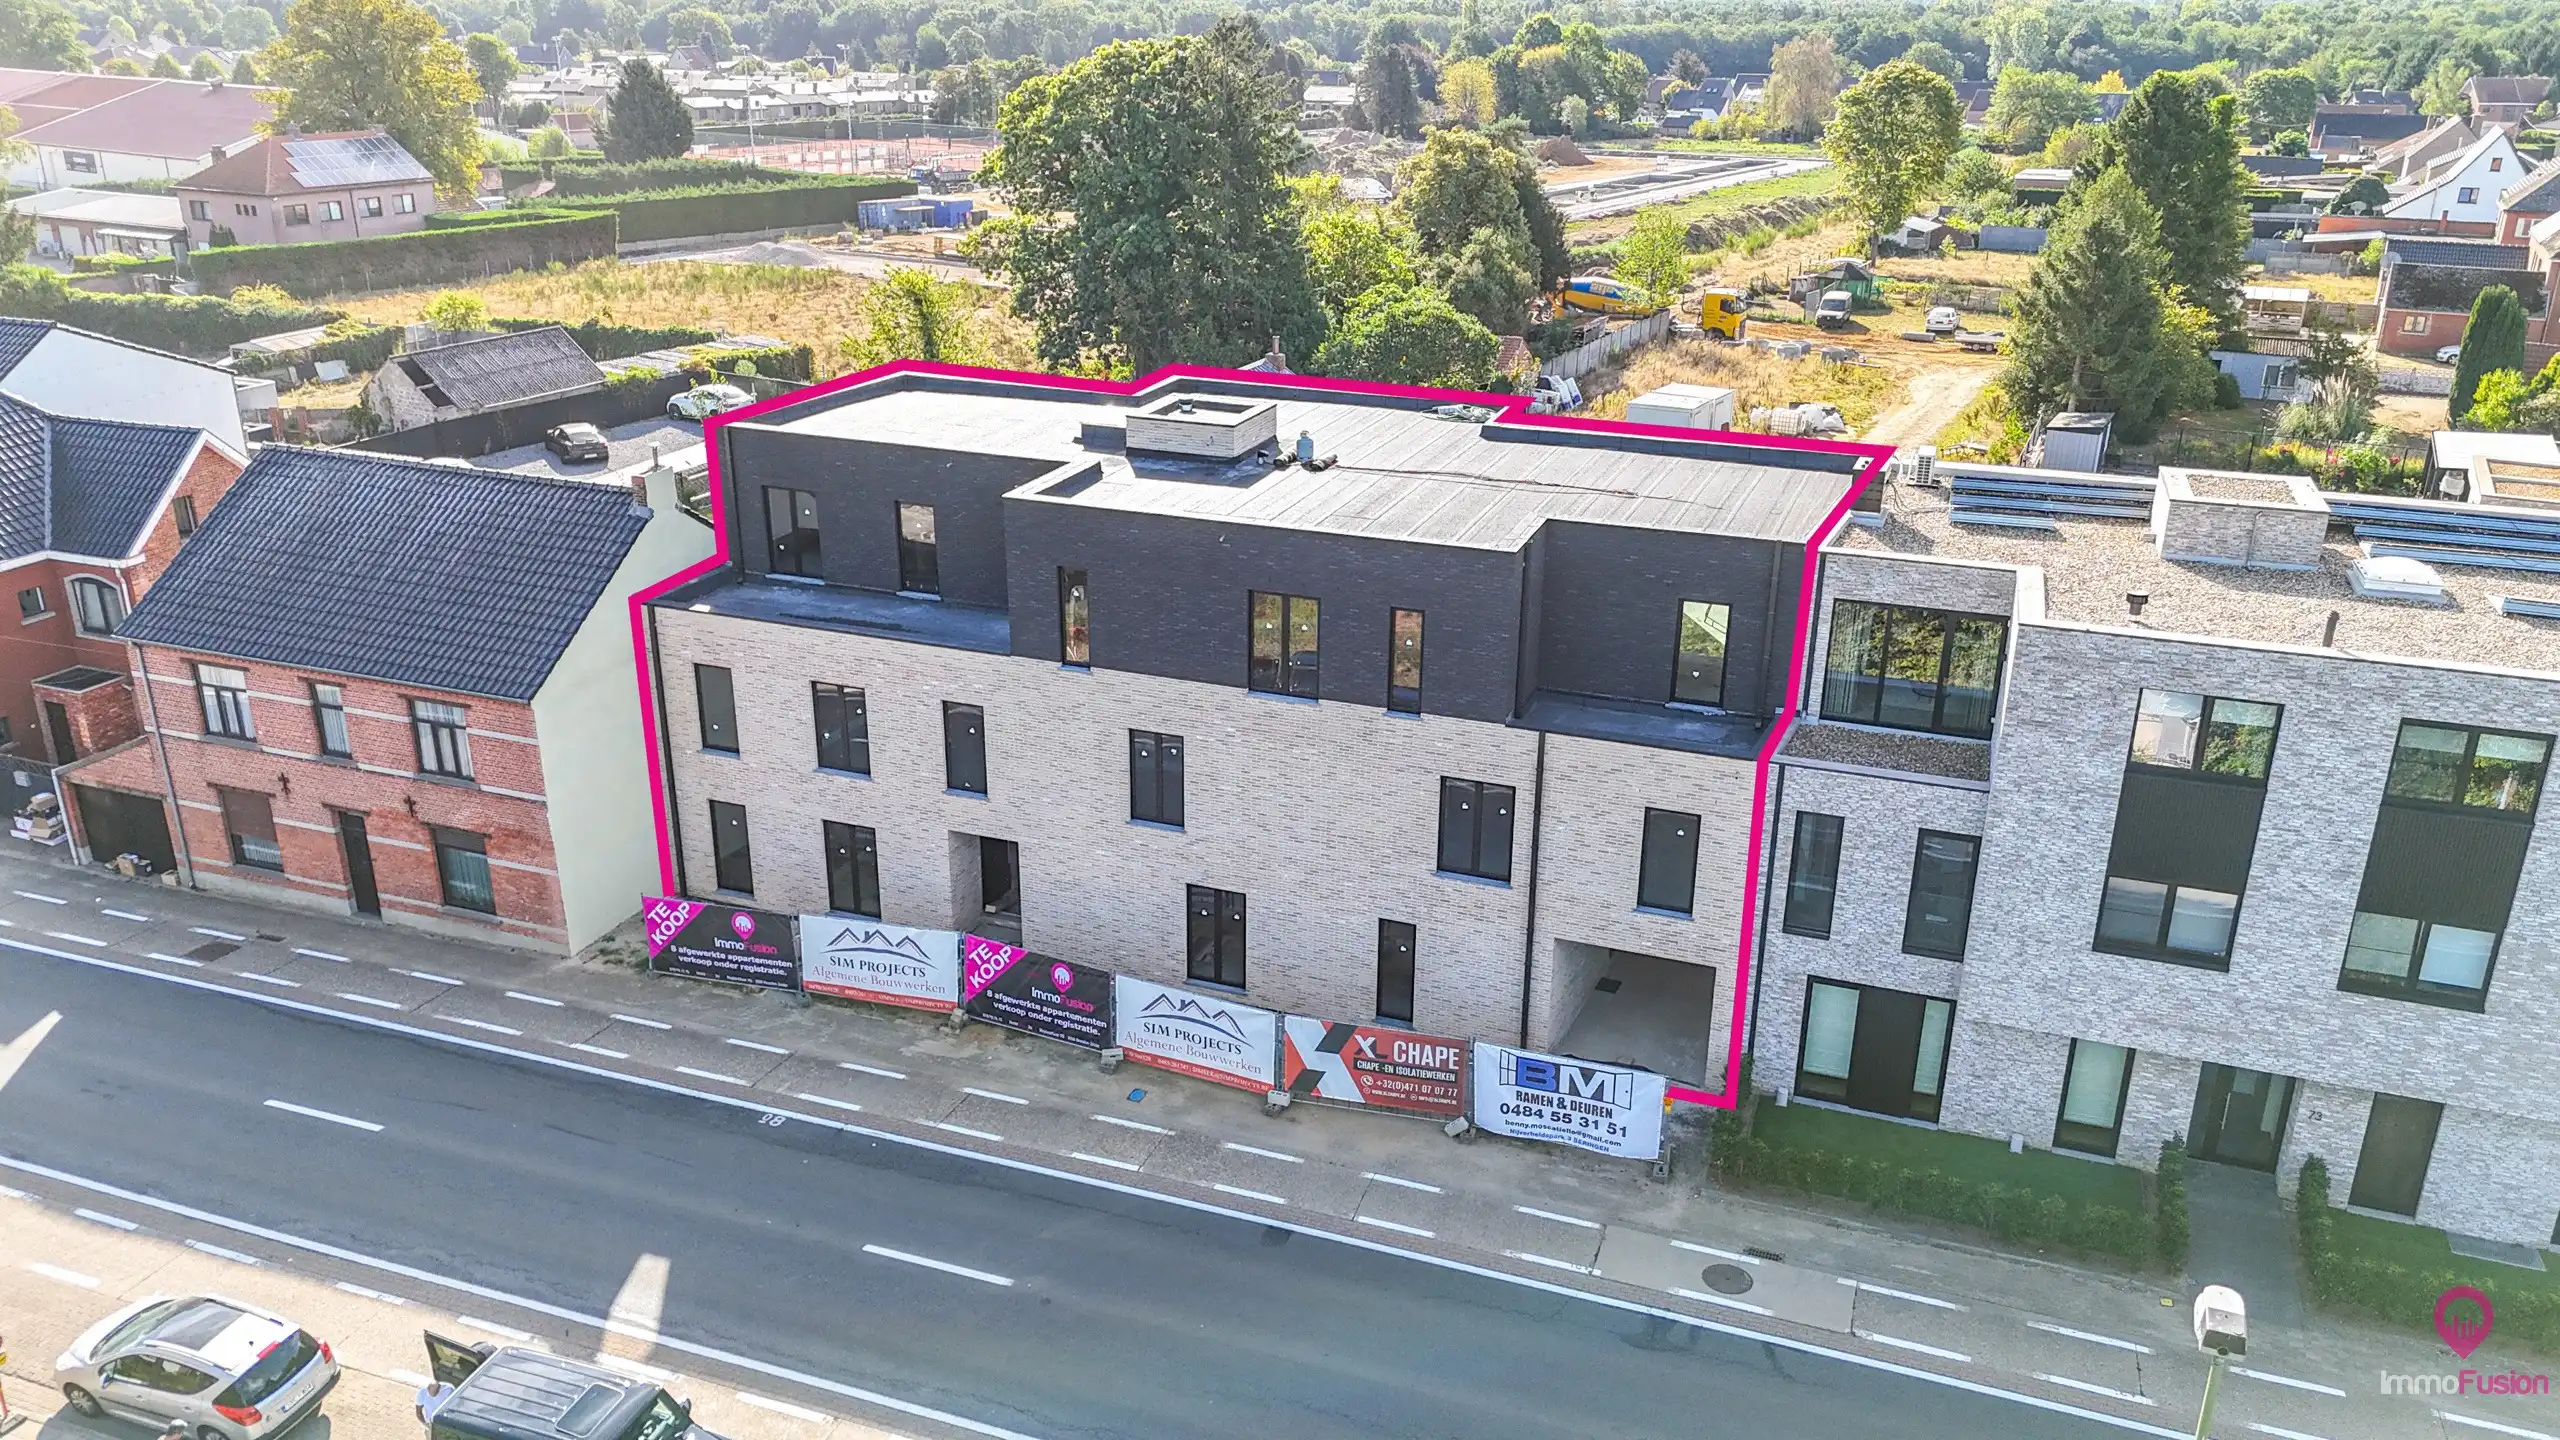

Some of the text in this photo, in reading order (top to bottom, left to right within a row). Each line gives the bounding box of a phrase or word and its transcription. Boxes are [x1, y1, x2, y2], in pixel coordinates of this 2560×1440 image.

[647, 901, 671, 924] TE
[651, 901, 691, 946] KOOP
[679, 945, 726, 960] afgewerkte
[727, 953, 793, 968] appartementen
[714, 937, 778, 955] ImmoFusion
[969, 943, 993, 966] TE
[678, 955, 788, 976] verkoop onder registratie.
[812, 965, 867, 983] Algemene
[871, 975, 946, 994] Bouwwerken
[829, 955, 926, 978] SIM PROJECTS
[969, 945, 1012, 989] KOOP
[986, 989, 993, 997] 8
[994, 991, 1041, 1011] afgewerkte
[1042, 1005, 1107, 1028] appartementen
[1031, 987, 1094, 1012] ImmoFusion
[993, 1001, 1027, 1017] verkoop
[1028, 1011, 1052, 1023] onder
[1054, 1018, 1101, 1036] registratie.
[1143, 1021, 1242, 1055] SIM PROJECTS
[1354, 1034, 1460, 1070] XL CHAPE
[1124, 1031, 1183, 1053] Algemene
[1186, 1044, 1262, 1075] Bouwwerken
[1357, 1060, 1379, 1071] CHAPE
[1396, 1067, 1456, 1082] ISOLATIEWERKEN
[1516, 1057, 1615, 1104] BM
[1375, 1079, 1458, 1097] +32(0)471 07 07 77
[1516, 1090, 1613, 1119] RAMEN & DEUREN
[2308, 1110, 2323, 1121] 73
[1500, 1103, 1627, 1138] 0484 55 31 51
[1505, 1119, 1622, 1147] benny.moscatiello@gmail.com
[1509, 1128, 1566, 1142] Nijverheidspark
[1573, 1137, 1610, 1153] BERINGEN
